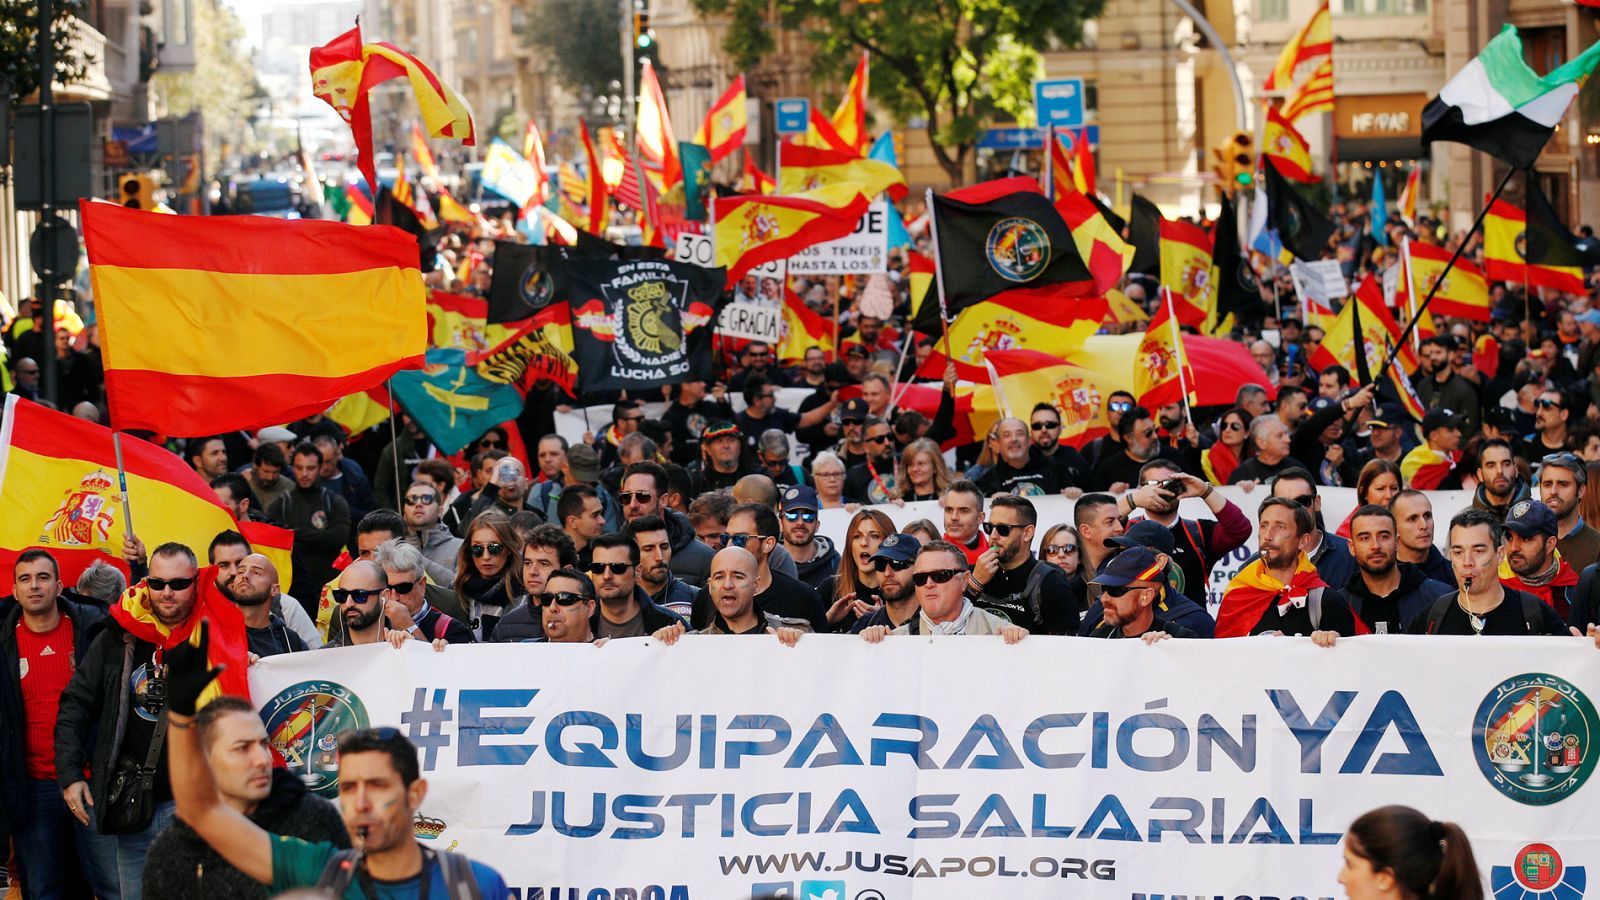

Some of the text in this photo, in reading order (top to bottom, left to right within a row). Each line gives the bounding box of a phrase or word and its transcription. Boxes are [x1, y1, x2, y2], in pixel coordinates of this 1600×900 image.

[832, 245, 881, 257] TENÉIS
[618, 261, 670, 275] EN ESTA
[791, 260, 837, 271] HASTA
[611, 271, 679, 289] FAMILIA
[641, 350, 682, 366] NADIE
[611, 365, 667, 380] LUCHA
[273, 683, 353, 711] JUSAPOL
[1496, 676, 1580, 702] JUSAPOL
[503, 789, 1345, 846] JUSTICIA SALARIAL
[719, 850, 1116, 881] WWW.JUSAPOL.ORG
